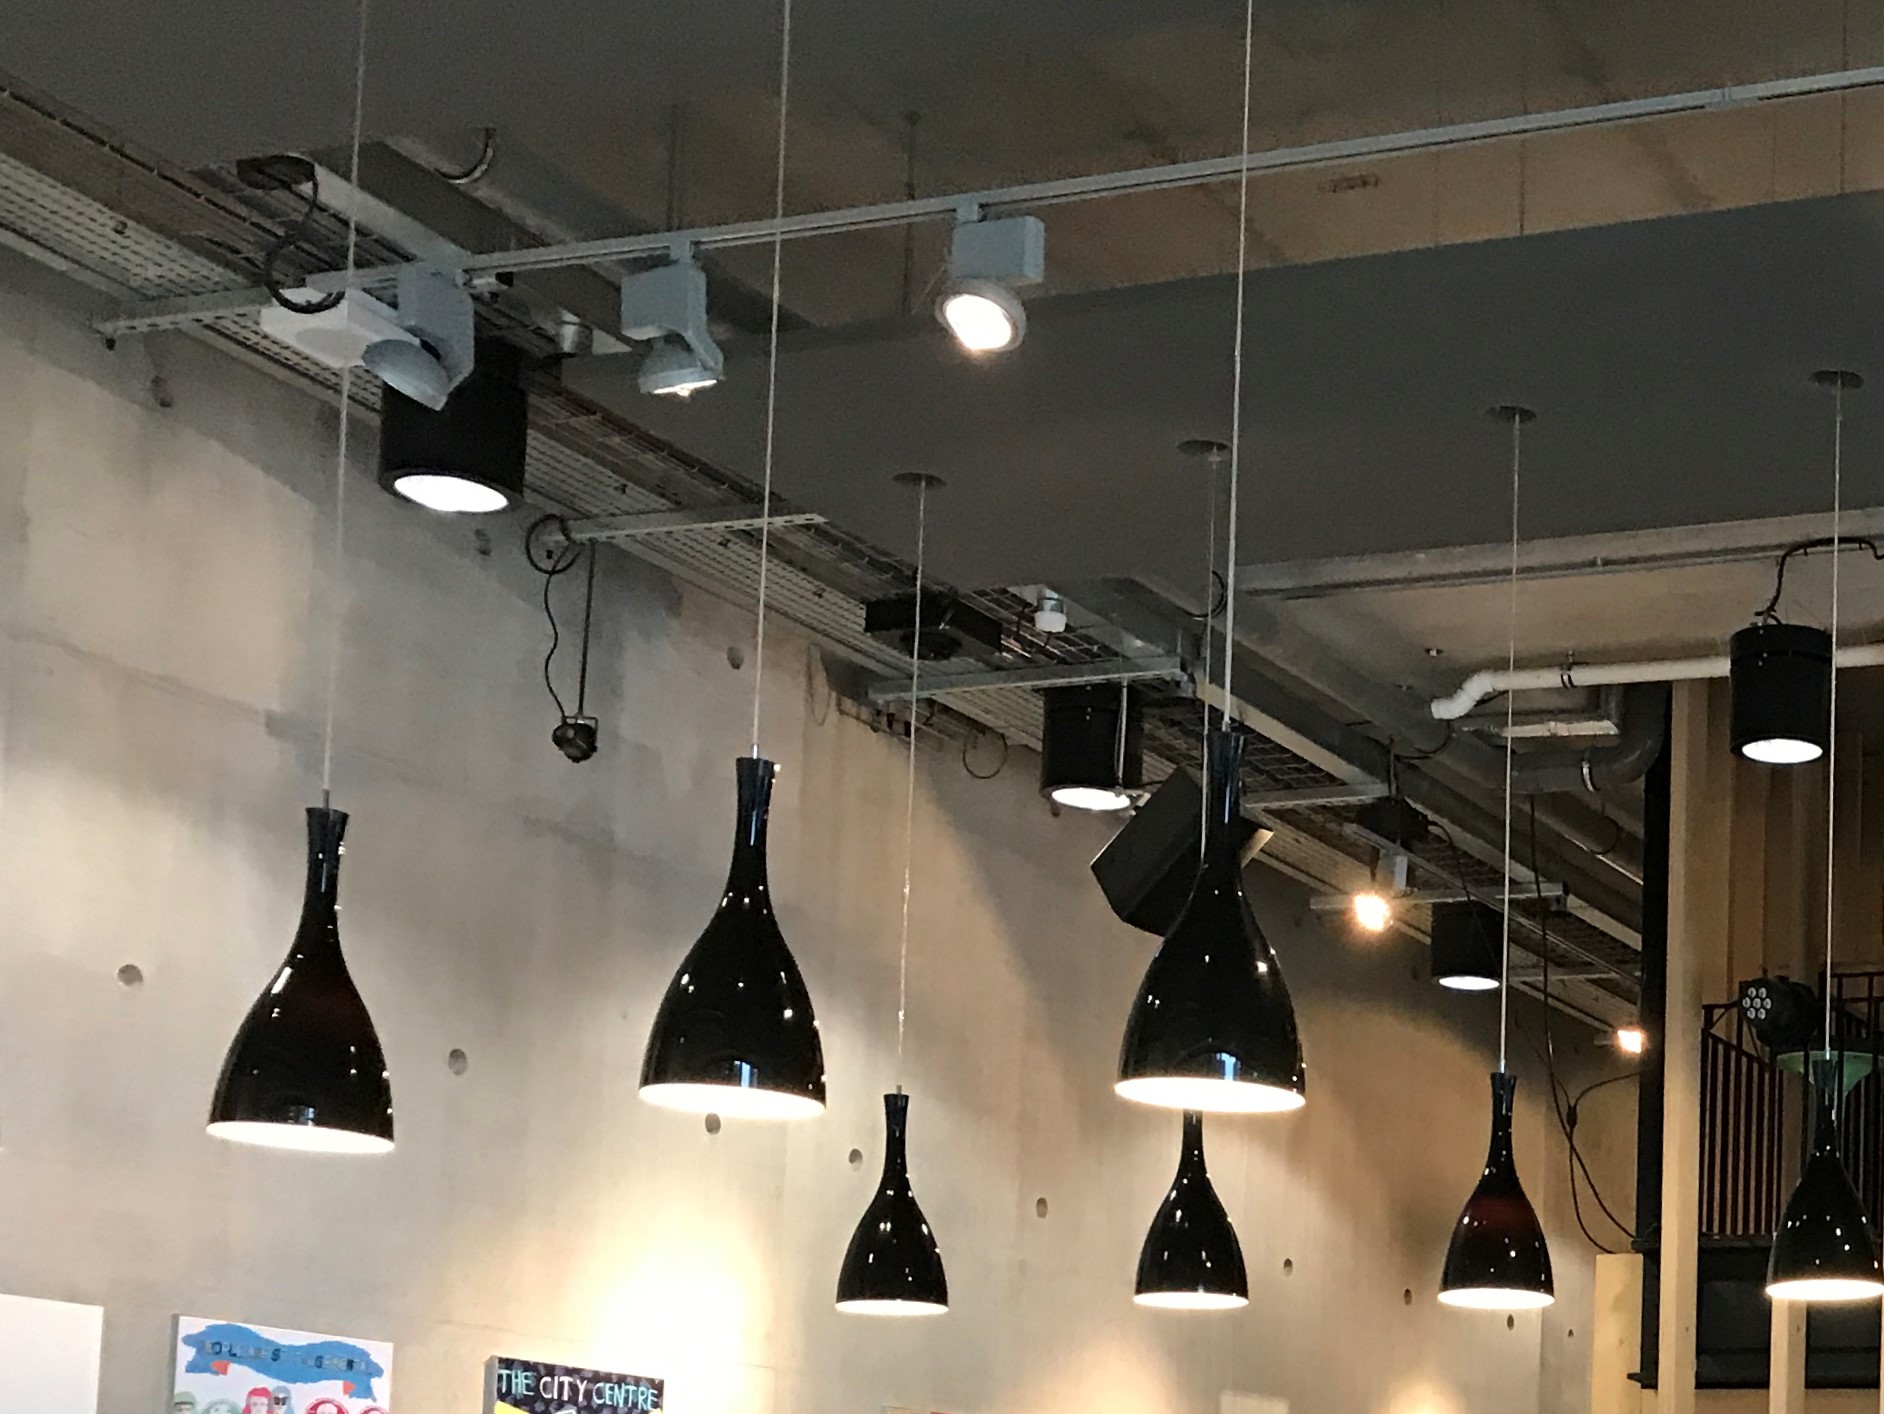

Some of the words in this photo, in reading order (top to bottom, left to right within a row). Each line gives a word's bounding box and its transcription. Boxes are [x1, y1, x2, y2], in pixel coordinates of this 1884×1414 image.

[498, 1369, 535, 1396] THE
[539, 1376, 588, 1401] CITY
[592, 1382, 659, 1411] CENTRE
